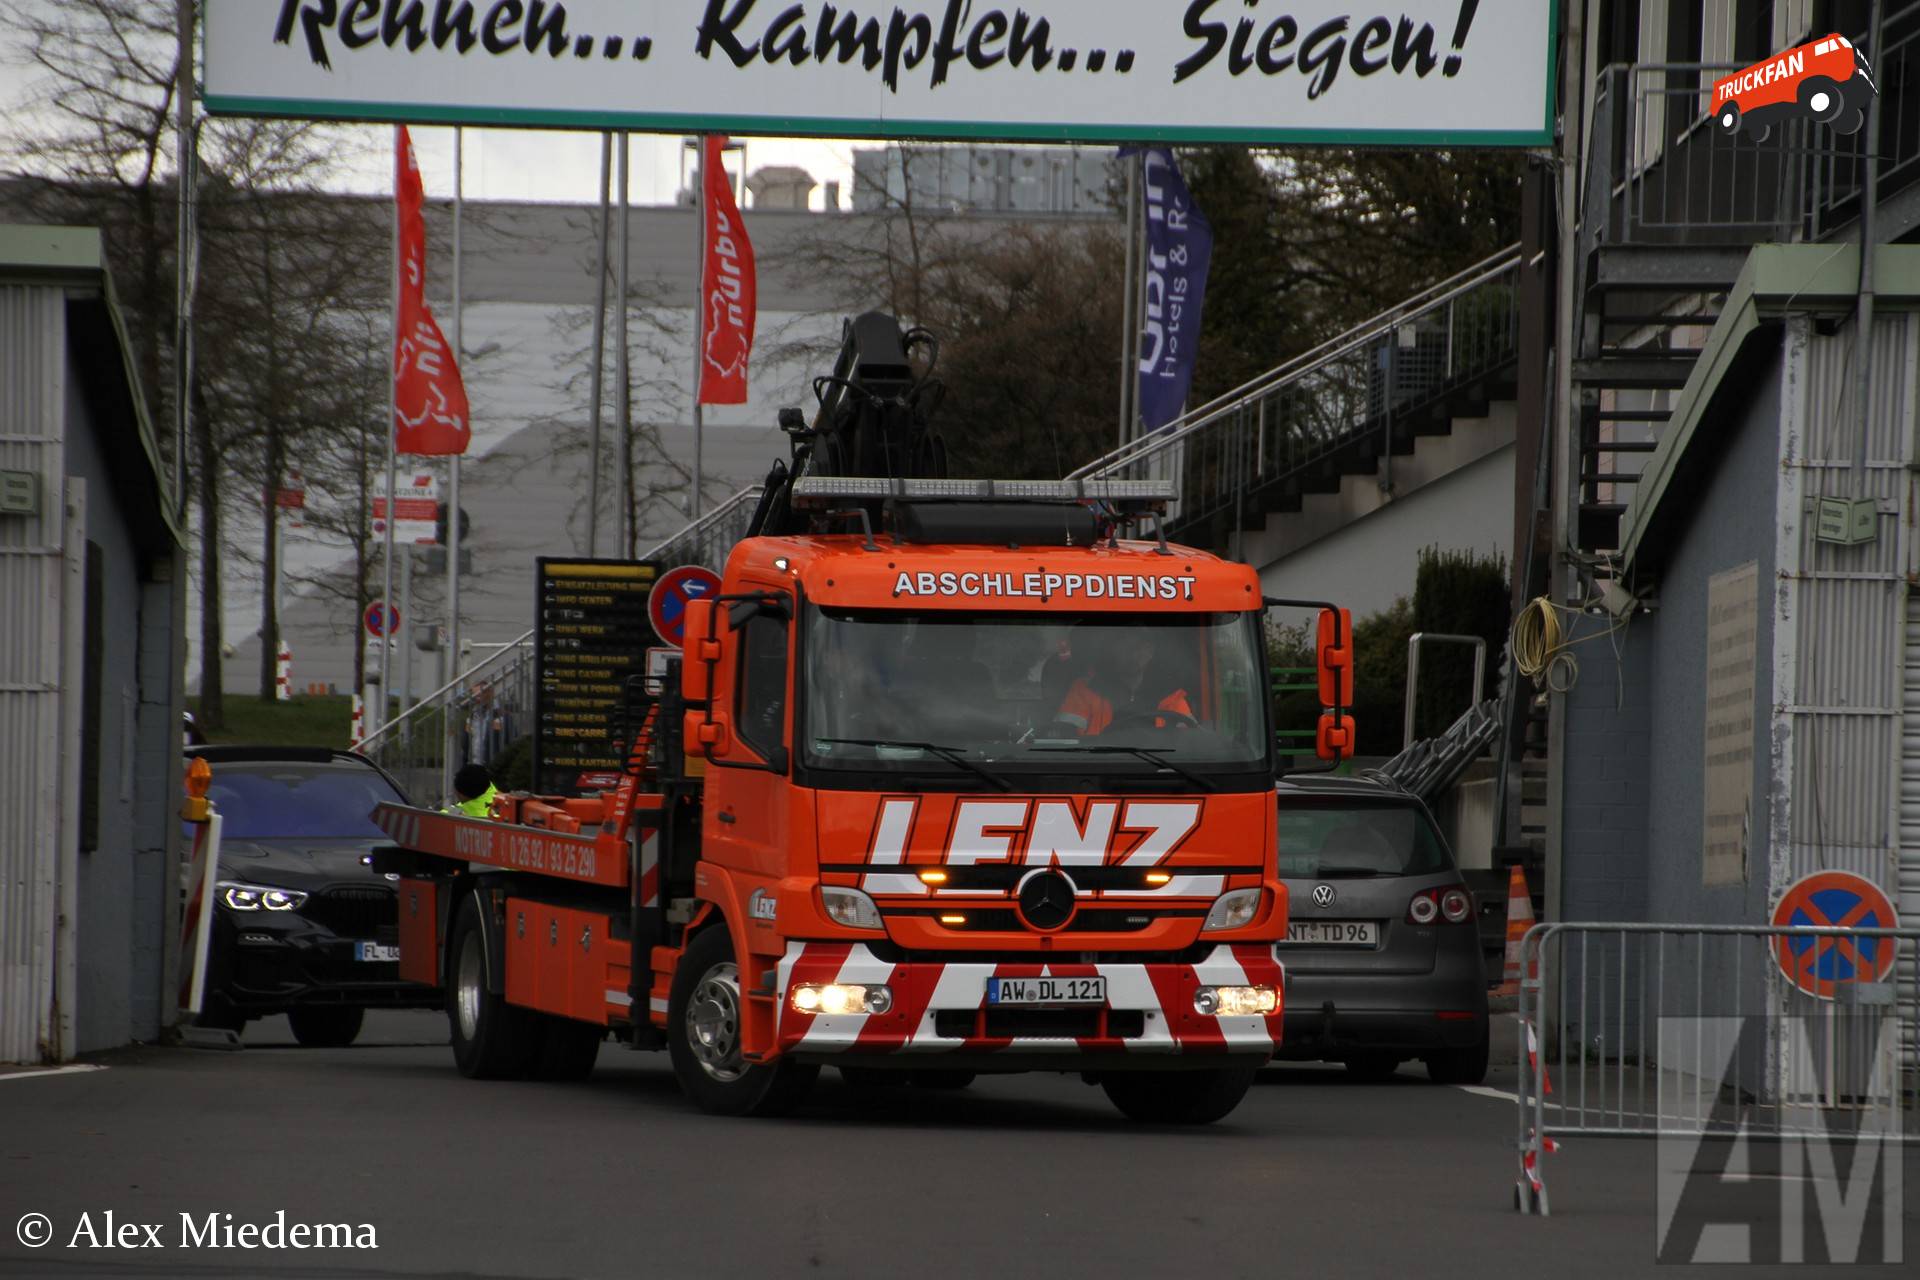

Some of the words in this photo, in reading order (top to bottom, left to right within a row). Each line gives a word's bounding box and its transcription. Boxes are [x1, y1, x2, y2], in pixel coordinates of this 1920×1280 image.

[1173, 0, 1480, 100] Siegen!
[1168, 196, 1188, 230] R
[715, 197, 744, 327] nürbu
[1159, 277, 1187, 378] Hotels
[894, 572, 1196, 599] ABSCHLEPPDIENST
[455, 826, 494, 858] NOTRUF
[531, 838, 544, 869] 92
[550, 841, 563, 872] 93
[564, 844, 577, 874] 25
[578, 846, 596, 878] 290
[858, 798, 1224, 895] LENZ
[1320, 924, 1343, 941] TD
[1347, 924, 1368, 941] 96
[1001, 981, 1025, 1000] AW
[1038, 980, 1063, 999] DL
[1067, 980, 1103, 999] 121
